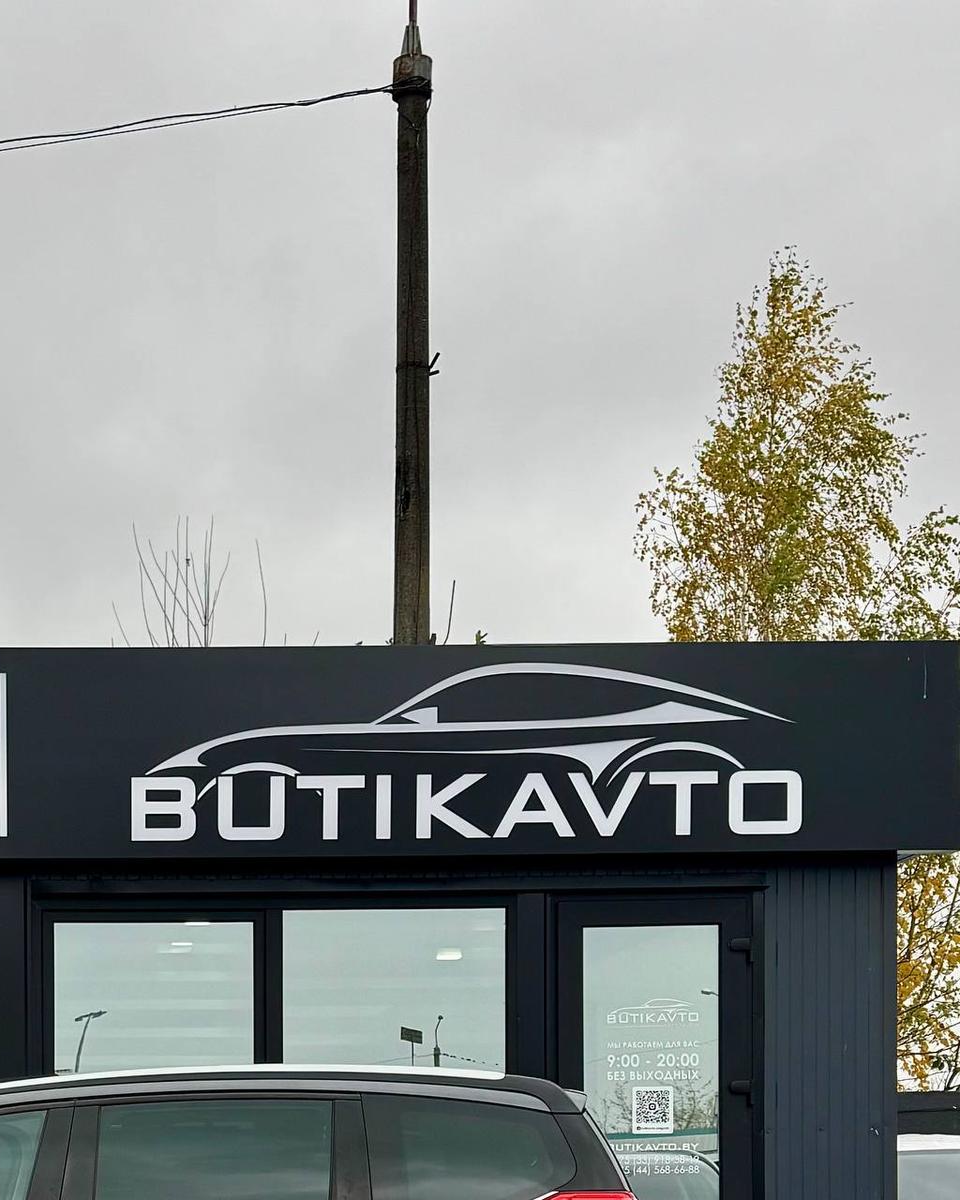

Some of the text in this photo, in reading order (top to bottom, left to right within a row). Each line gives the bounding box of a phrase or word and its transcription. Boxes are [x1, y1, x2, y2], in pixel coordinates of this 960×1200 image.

[130, 769, 803, 843] BUTIKAVTO
[607, 1012, 699, 1023] BUTIKAVTO
[607, 1040, 700, 1049] МЫ РАБОТАЕМ ДЛЯ ВАС
[607, 1054, 640, 1067] 9:00
[657, 1053, 699, 1067] 20:00
[607, 1069, 700, 1081] БЕЗ ВЫХОДНЫХ
[633, 1165, 650, 1176] (44)
[654, 1165, 700, 1174] 568-66-88
